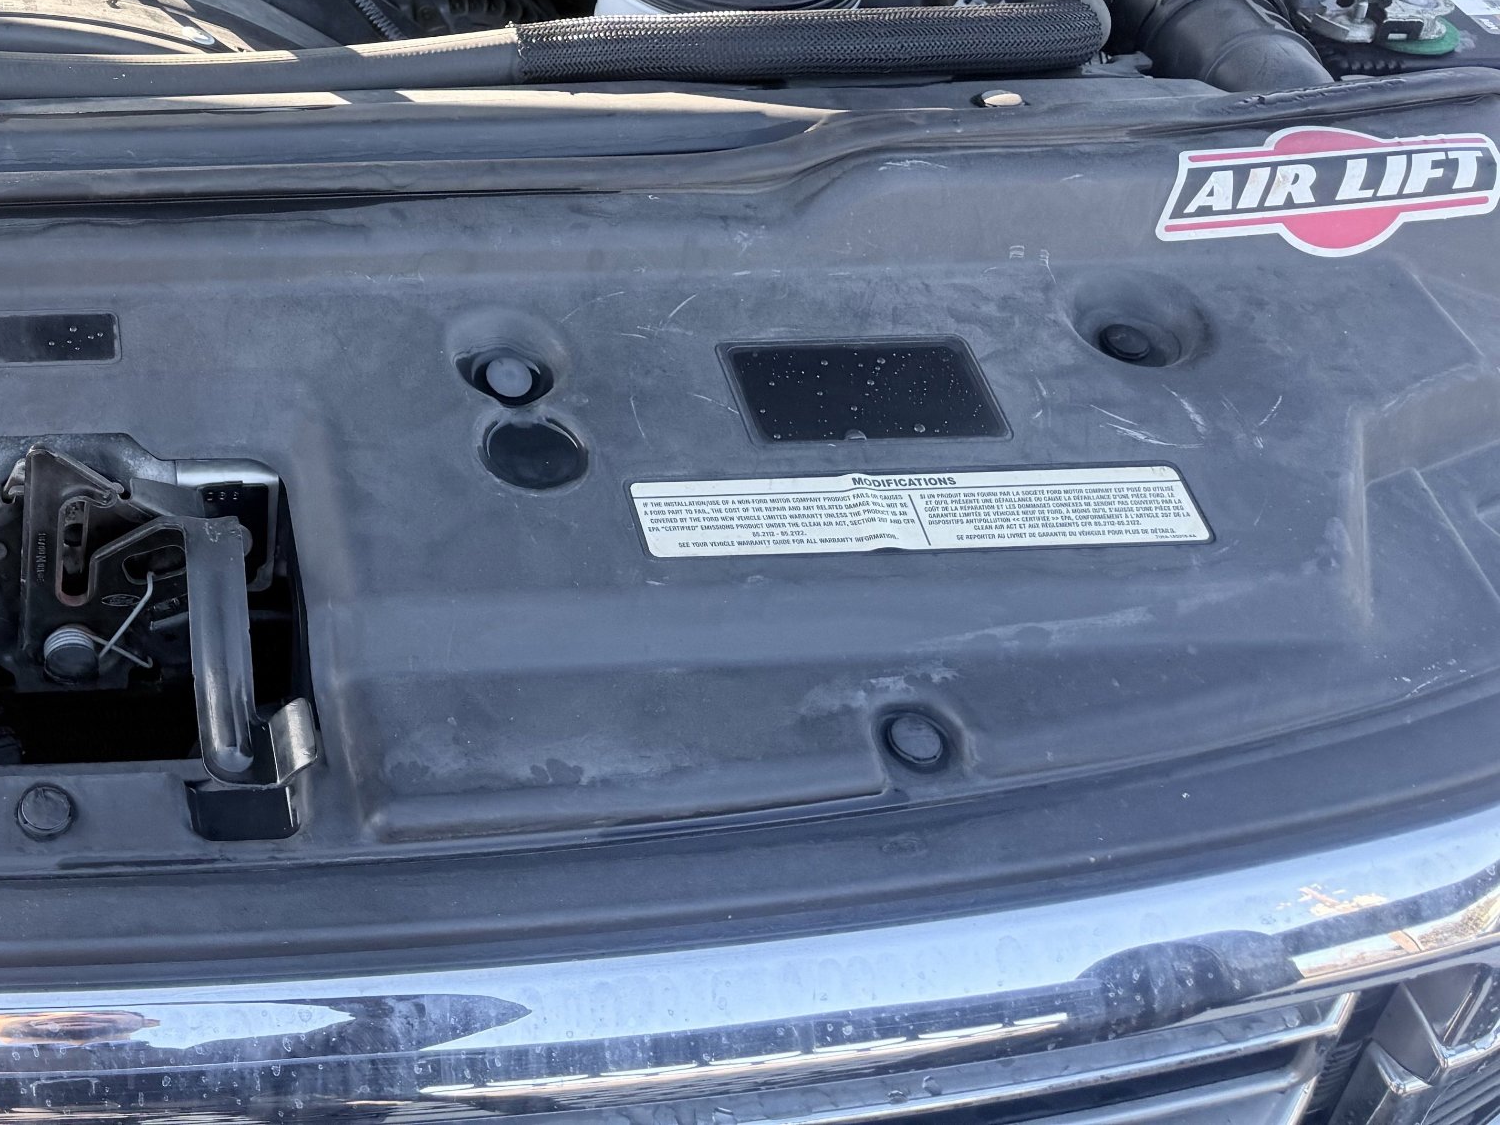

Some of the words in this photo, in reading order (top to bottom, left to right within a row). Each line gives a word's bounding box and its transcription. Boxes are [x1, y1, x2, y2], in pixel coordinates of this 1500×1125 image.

[1183, 163, 1317, 214] AIR
[1334, 150, 1483, 201] LIFT
[851, 476, 957, 488] MODIFICATIONS
